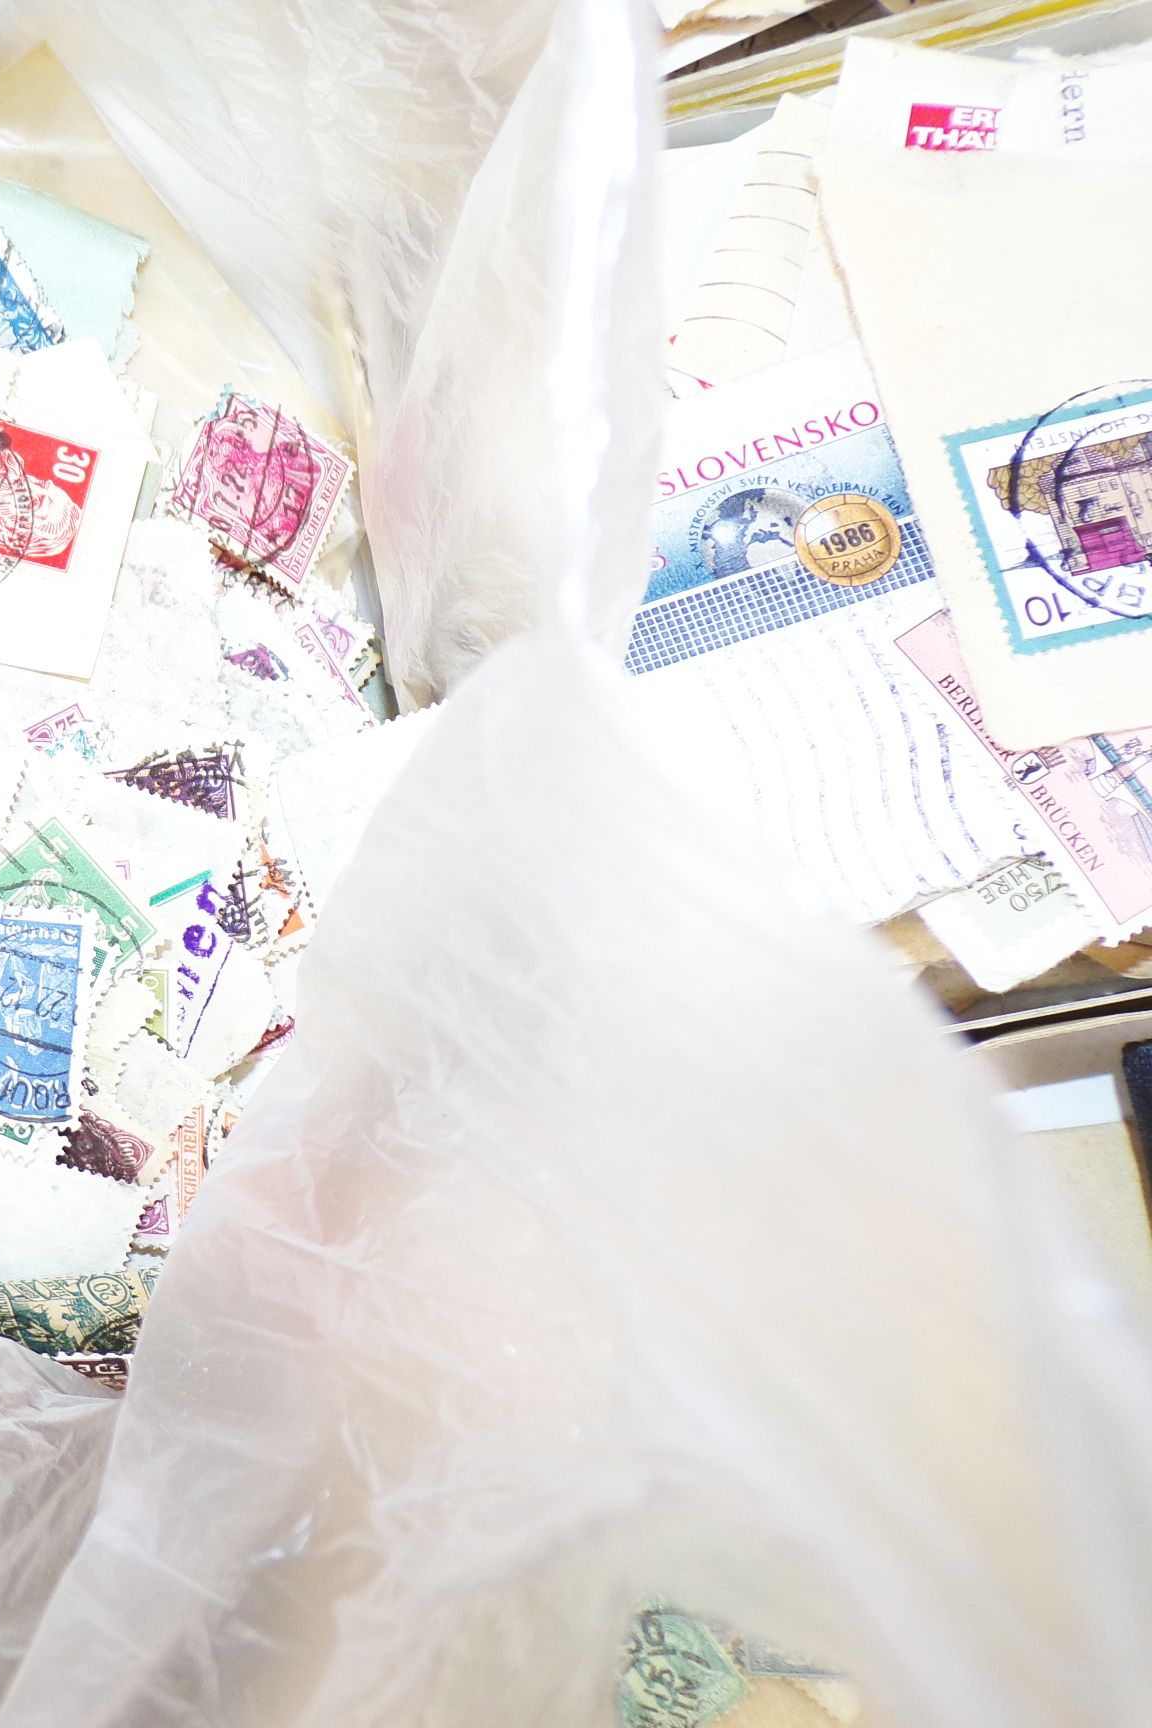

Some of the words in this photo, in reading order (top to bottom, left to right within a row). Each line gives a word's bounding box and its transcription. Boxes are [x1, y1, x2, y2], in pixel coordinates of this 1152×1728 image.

[51, 445, 91, 484] 30
[786, 480, 805, 492] VE
[289, 503, 327, 575] DEUTSCHES
[320, 462, 345, 500] REICH
[820, 523, 876, 556] 1986
[830, 547, 886, 574] PRAHA
[1024, 592, 1072, 628] 10
[1028, 784, 1105, 873] BRÜCKEN
[1008, 873, 1061, 913] 750
